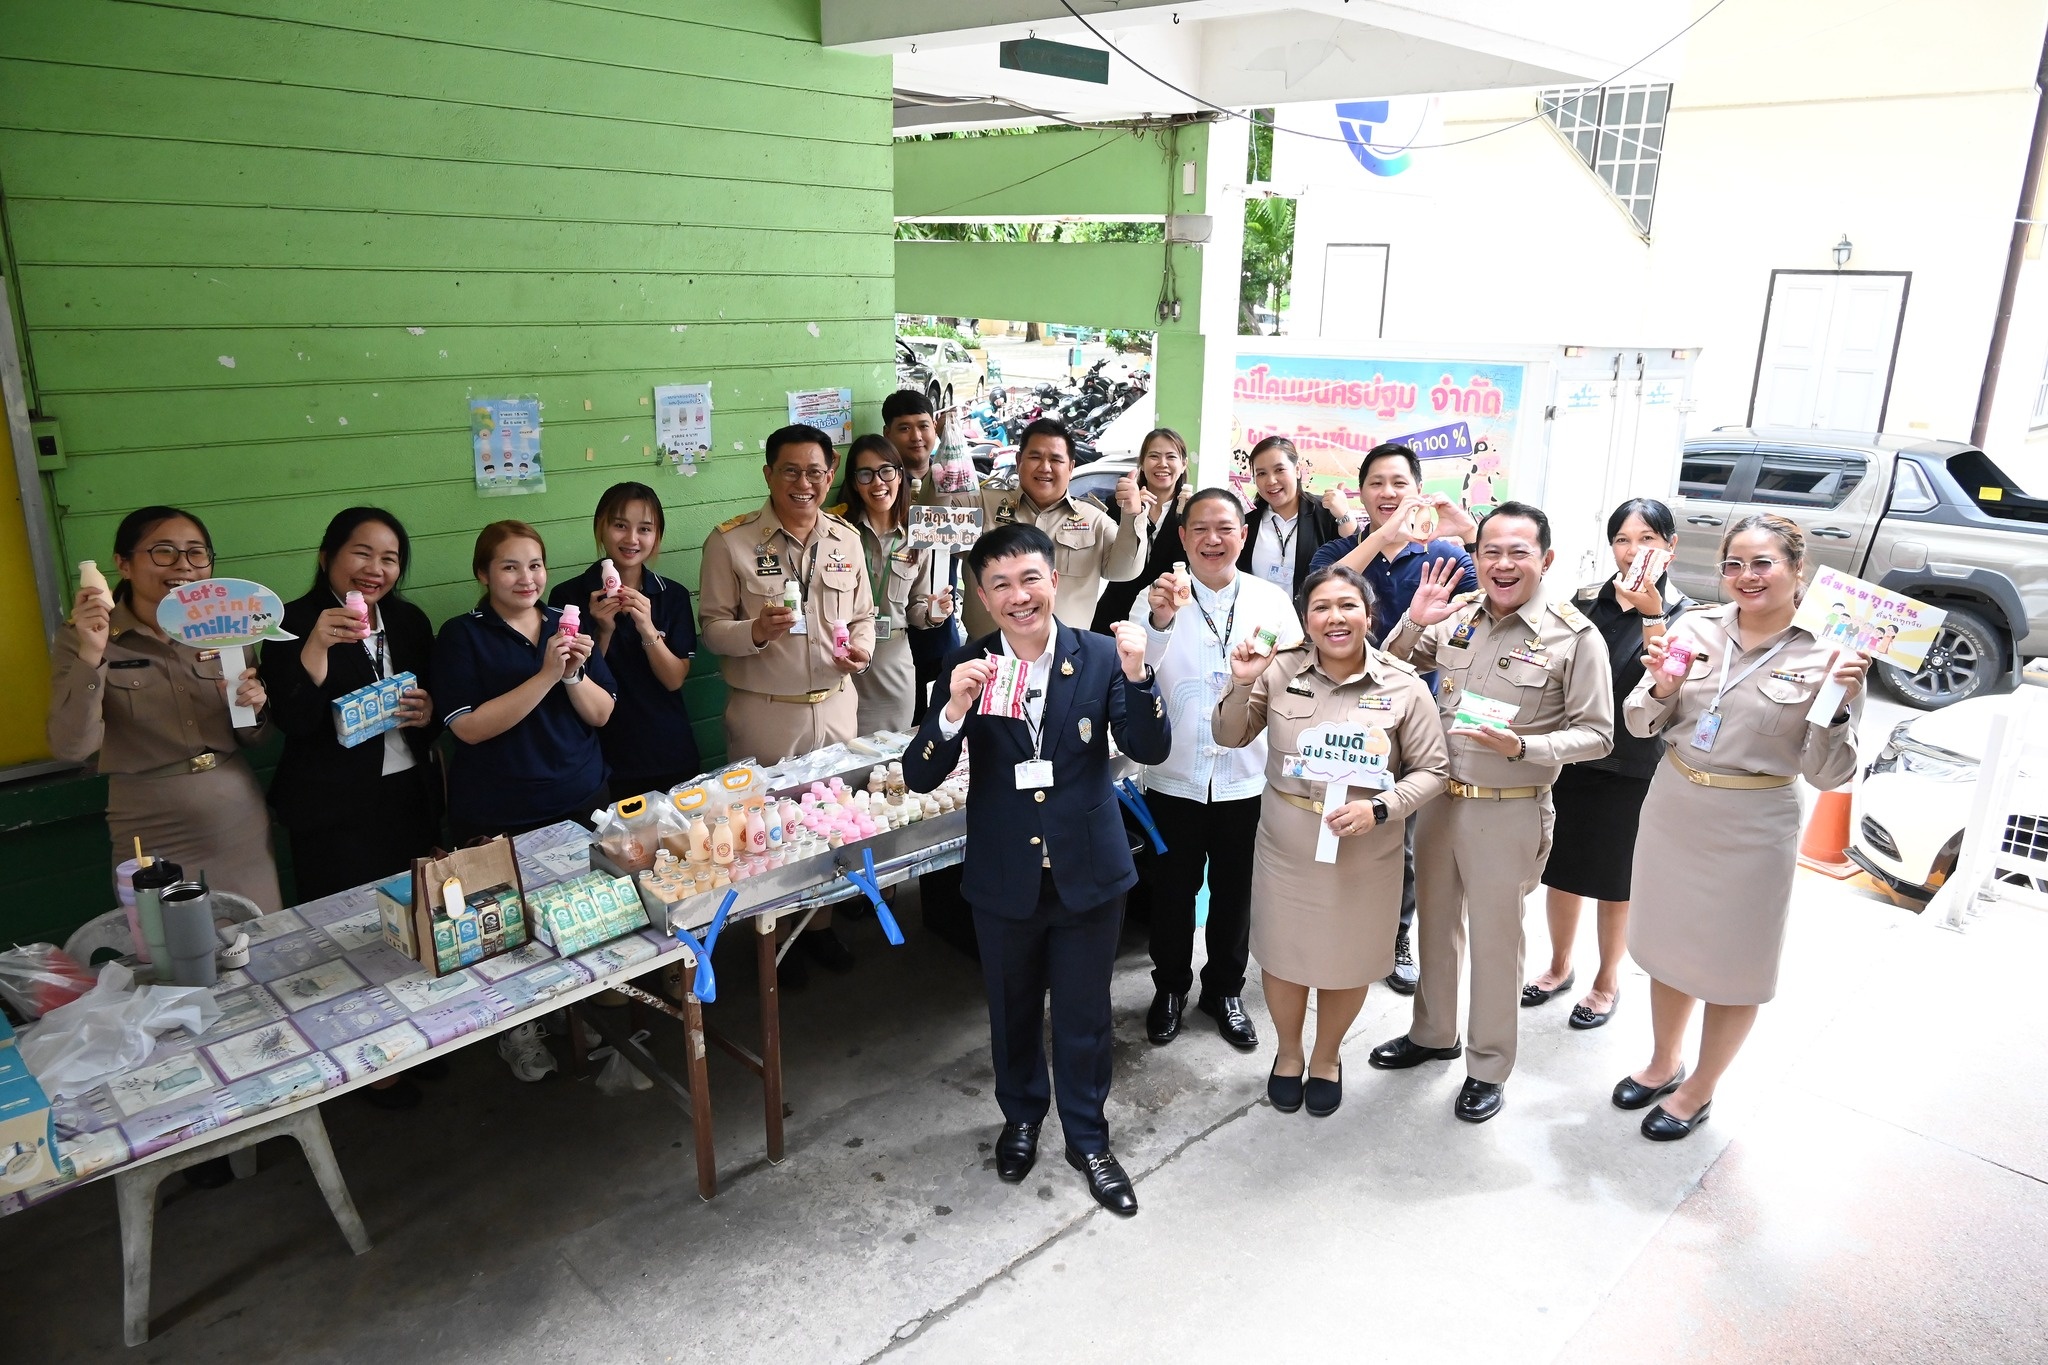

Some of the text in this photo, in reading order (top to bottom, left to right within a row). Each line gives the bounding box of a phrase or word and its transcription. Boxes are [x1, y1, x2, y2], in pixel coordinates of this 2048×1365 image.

[1431, 375, 1501, 415] จำกัด
[1424, 433, 1449, 451] 100
[915, 509, 975, 526] 1 มิถุนายน
[177, 583, 227, 605] Let's
[1820, 573, 1919, 619] ดื่มนมทุกวัน
[187, 597, 263, 620] drink
[183, 614, 249, 640] milk!
[1890, 673, 1930, 702] DUNLOP
[1324, 732, 1365, 750] นมดี
[1302, 745, 1380, 766] มีประโยชน์
